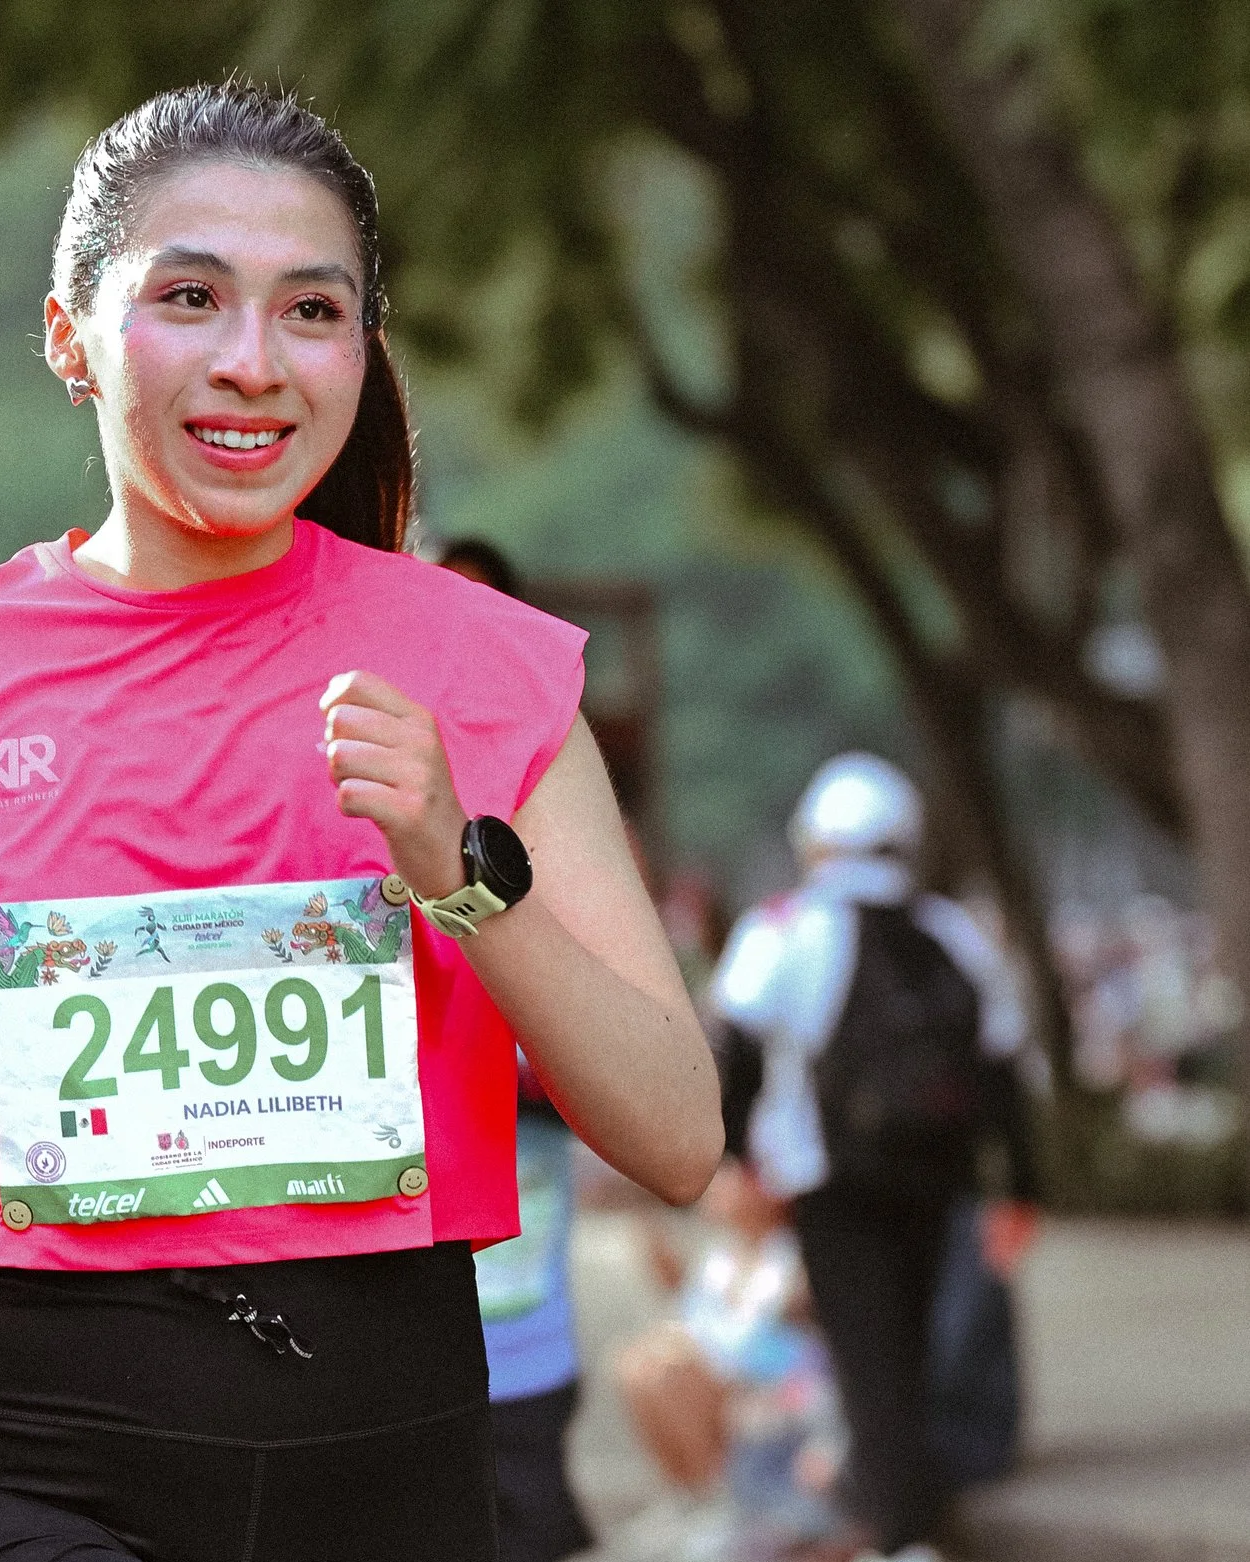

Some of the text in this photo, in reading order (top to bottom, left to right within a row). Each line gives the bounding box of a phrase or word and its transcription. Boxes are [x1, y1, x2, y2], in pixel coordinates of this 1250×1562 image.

[14, 788, 60, 806] RUNNERS
[195, 909, 243, 921] MARATÓN
[172, 923, 201, 931] CIUDAD
[214, 919, 244, 928] MÉXICO
[194, 931, 223, 942] telcel
[52, 974, 387, 1101] 24991
[183, 1095, 342, 1120] NADIA LILIBETH
[208, 1136, 265, 1150] INDEPORTE
[68, 1188, 146, 1217] telcel
